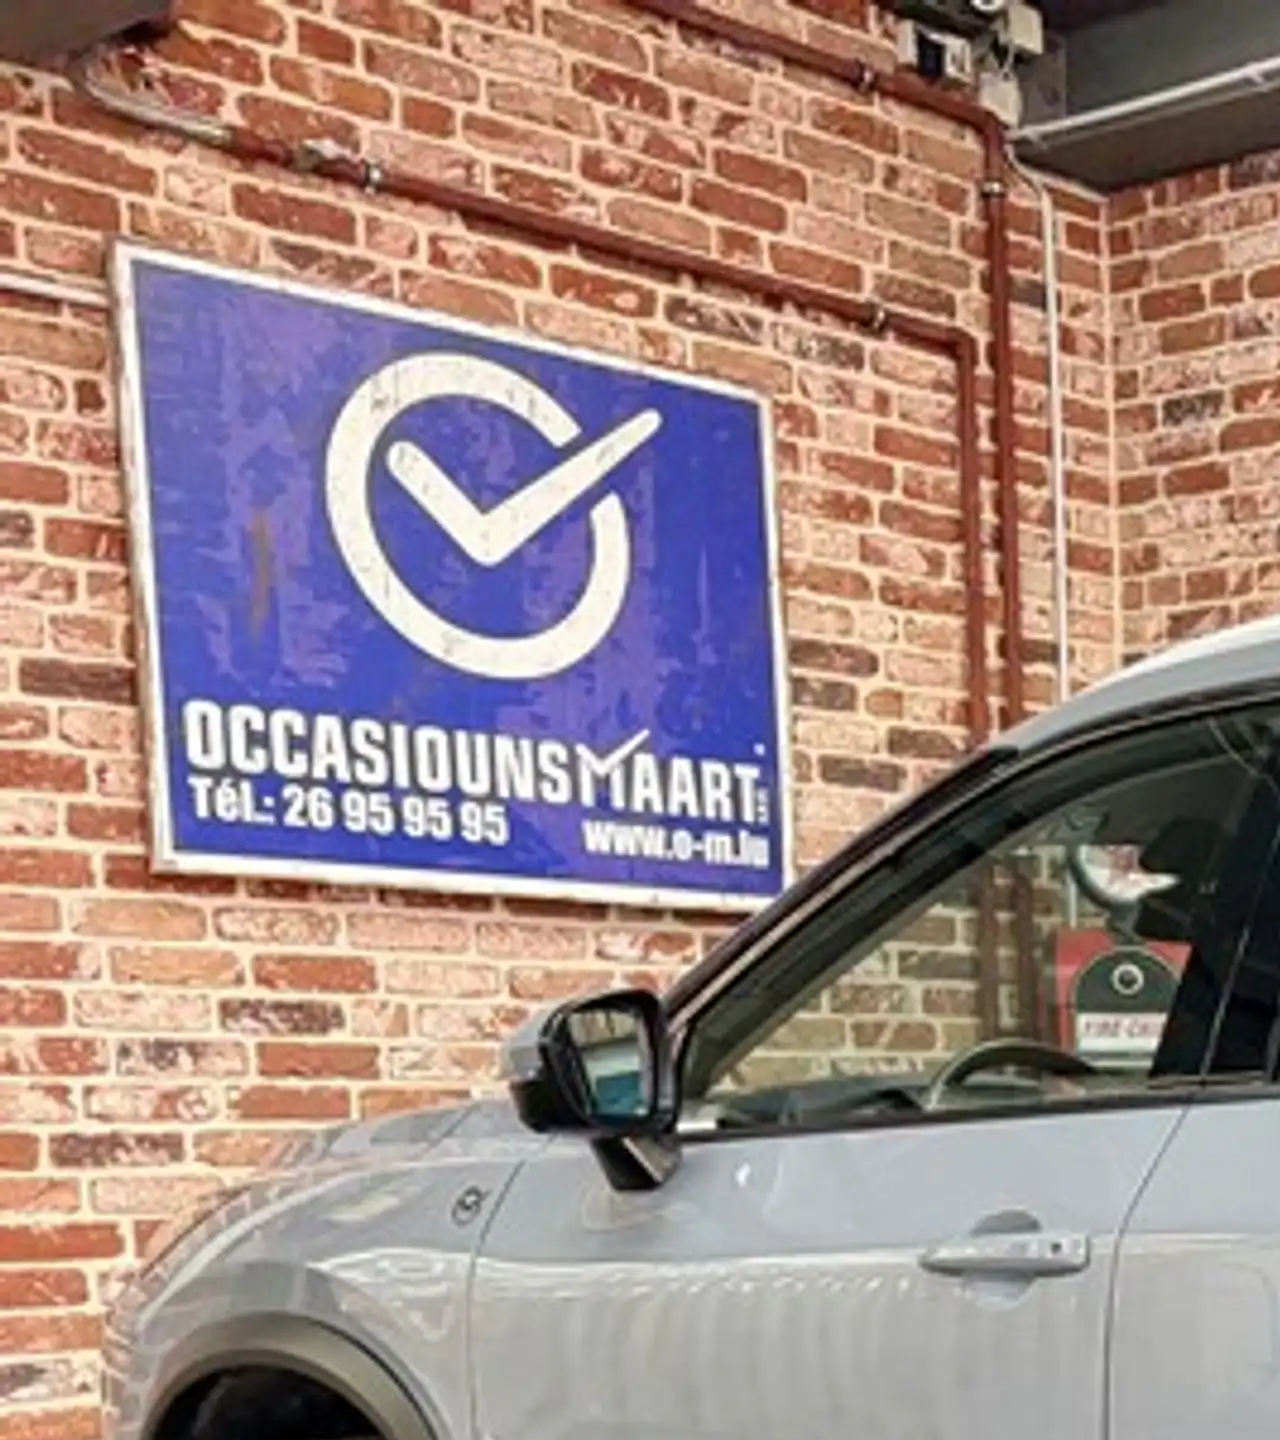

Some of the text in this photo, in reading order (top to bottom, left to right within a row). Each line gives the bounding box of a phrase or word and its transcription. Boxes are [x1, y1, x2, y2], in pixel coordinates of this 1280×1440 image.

[182, 699, 761, 824] OCCASIOUNSMAART
[281, 782, 335, 831] 26
[341, 788, 396, 837] 95
[402, 795, 454, 841] 95
[460, 800, 511, 847] 95
